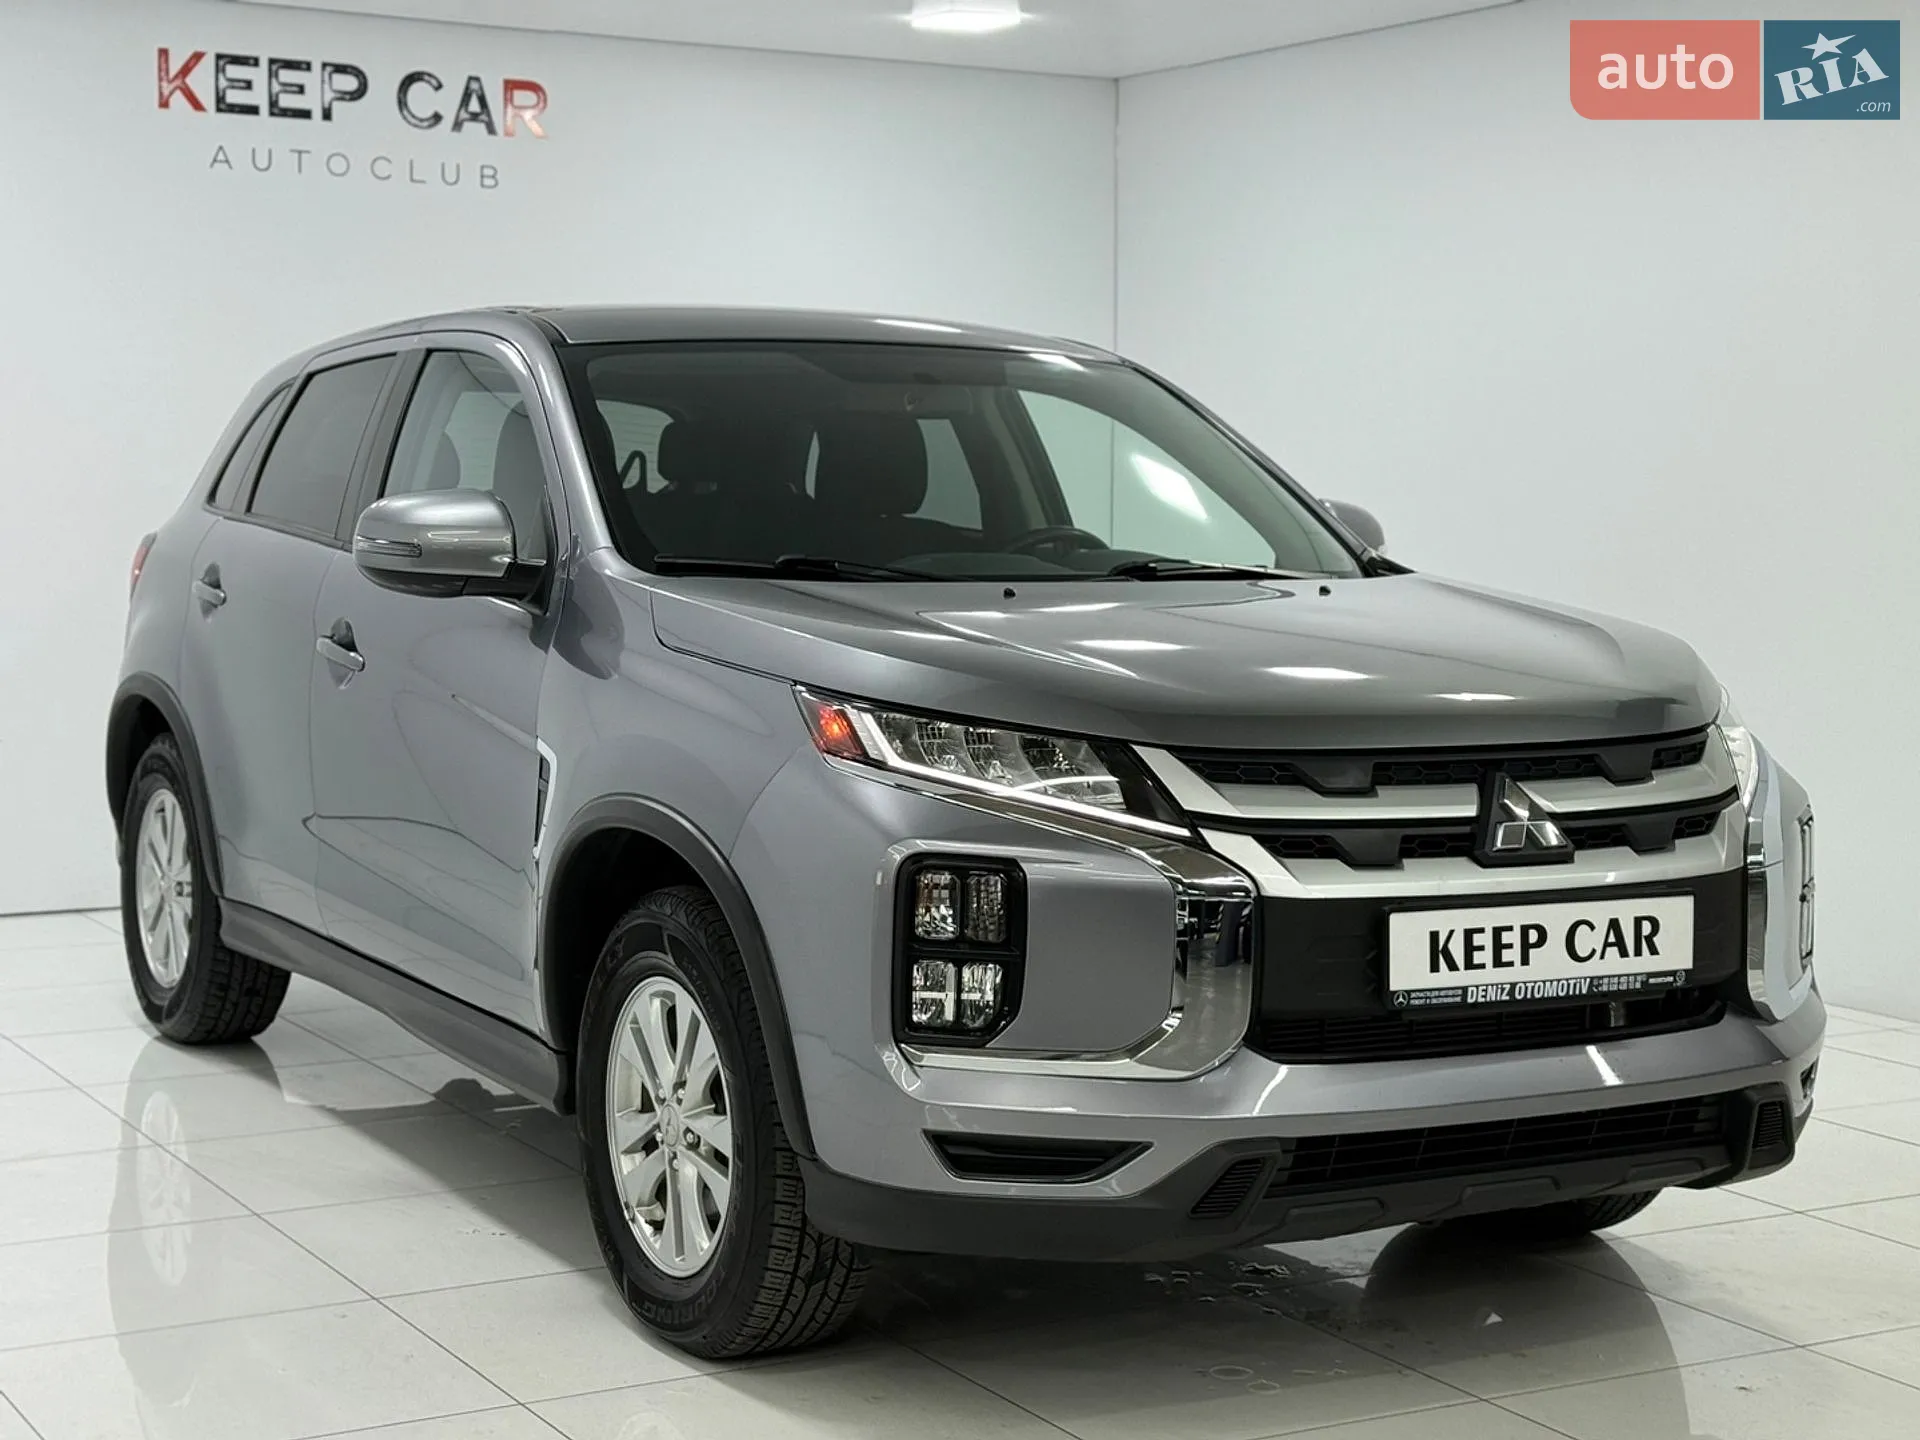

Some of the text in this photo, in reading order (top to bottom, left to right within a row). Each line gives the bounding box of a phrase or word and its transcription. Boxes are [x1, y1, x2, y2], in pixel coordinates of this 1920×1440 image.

[156, 47, 549, 139] KEEP CAR
[209, 144, 500, 189] AUTOCLUB
[1429, 915, 1660, 973] KEEP CAR
